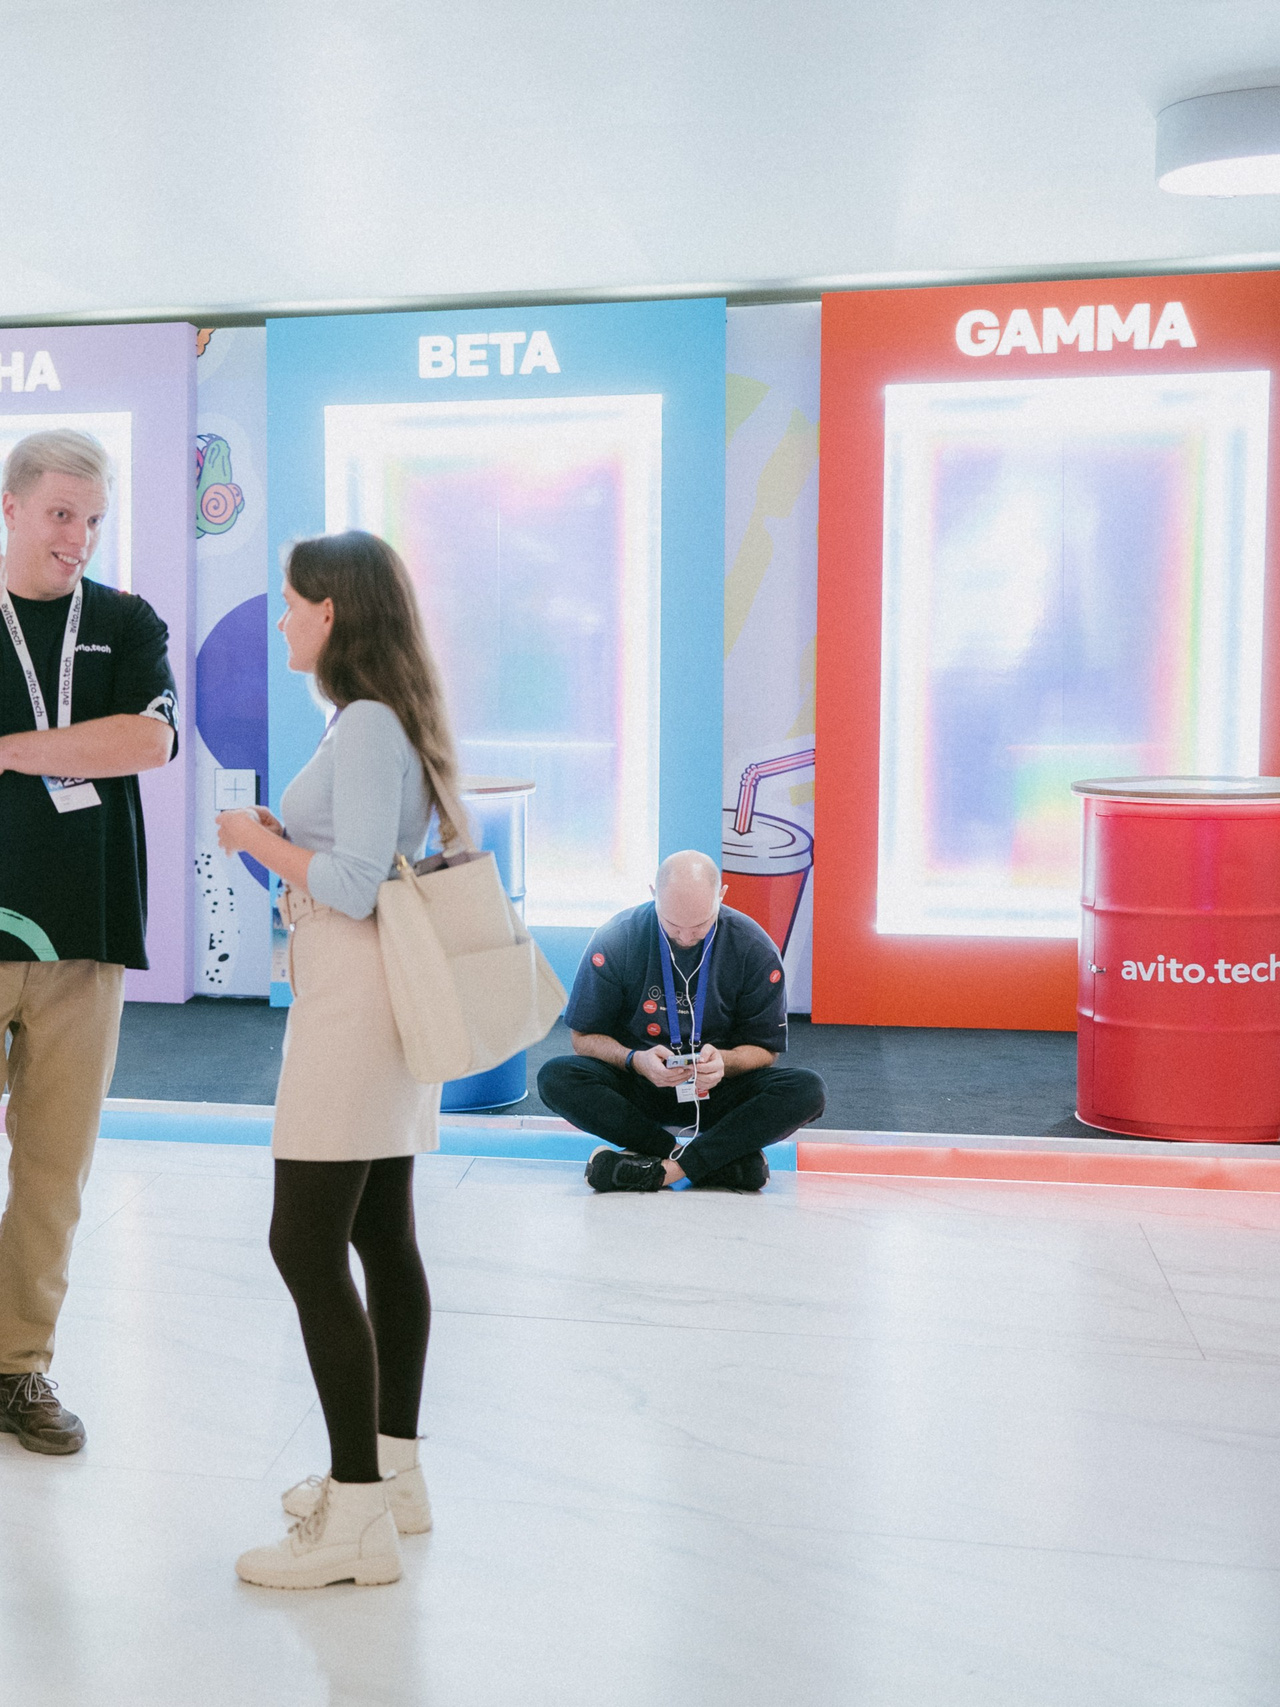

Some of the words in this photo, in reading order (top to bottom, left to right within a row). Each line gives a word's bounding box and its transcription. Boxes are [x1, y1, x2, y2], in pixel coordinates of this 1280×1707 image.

[955, 301, 1198, 357] GAMMA
[418, 330, 561, 379] BETA
[1, 603, 23, 646] avito.tech
[26, 669, 44, 718] avito.tech
[61, 656, 72, 706] avito.tech
[1121, 953, 1280, 984] avito.tech
